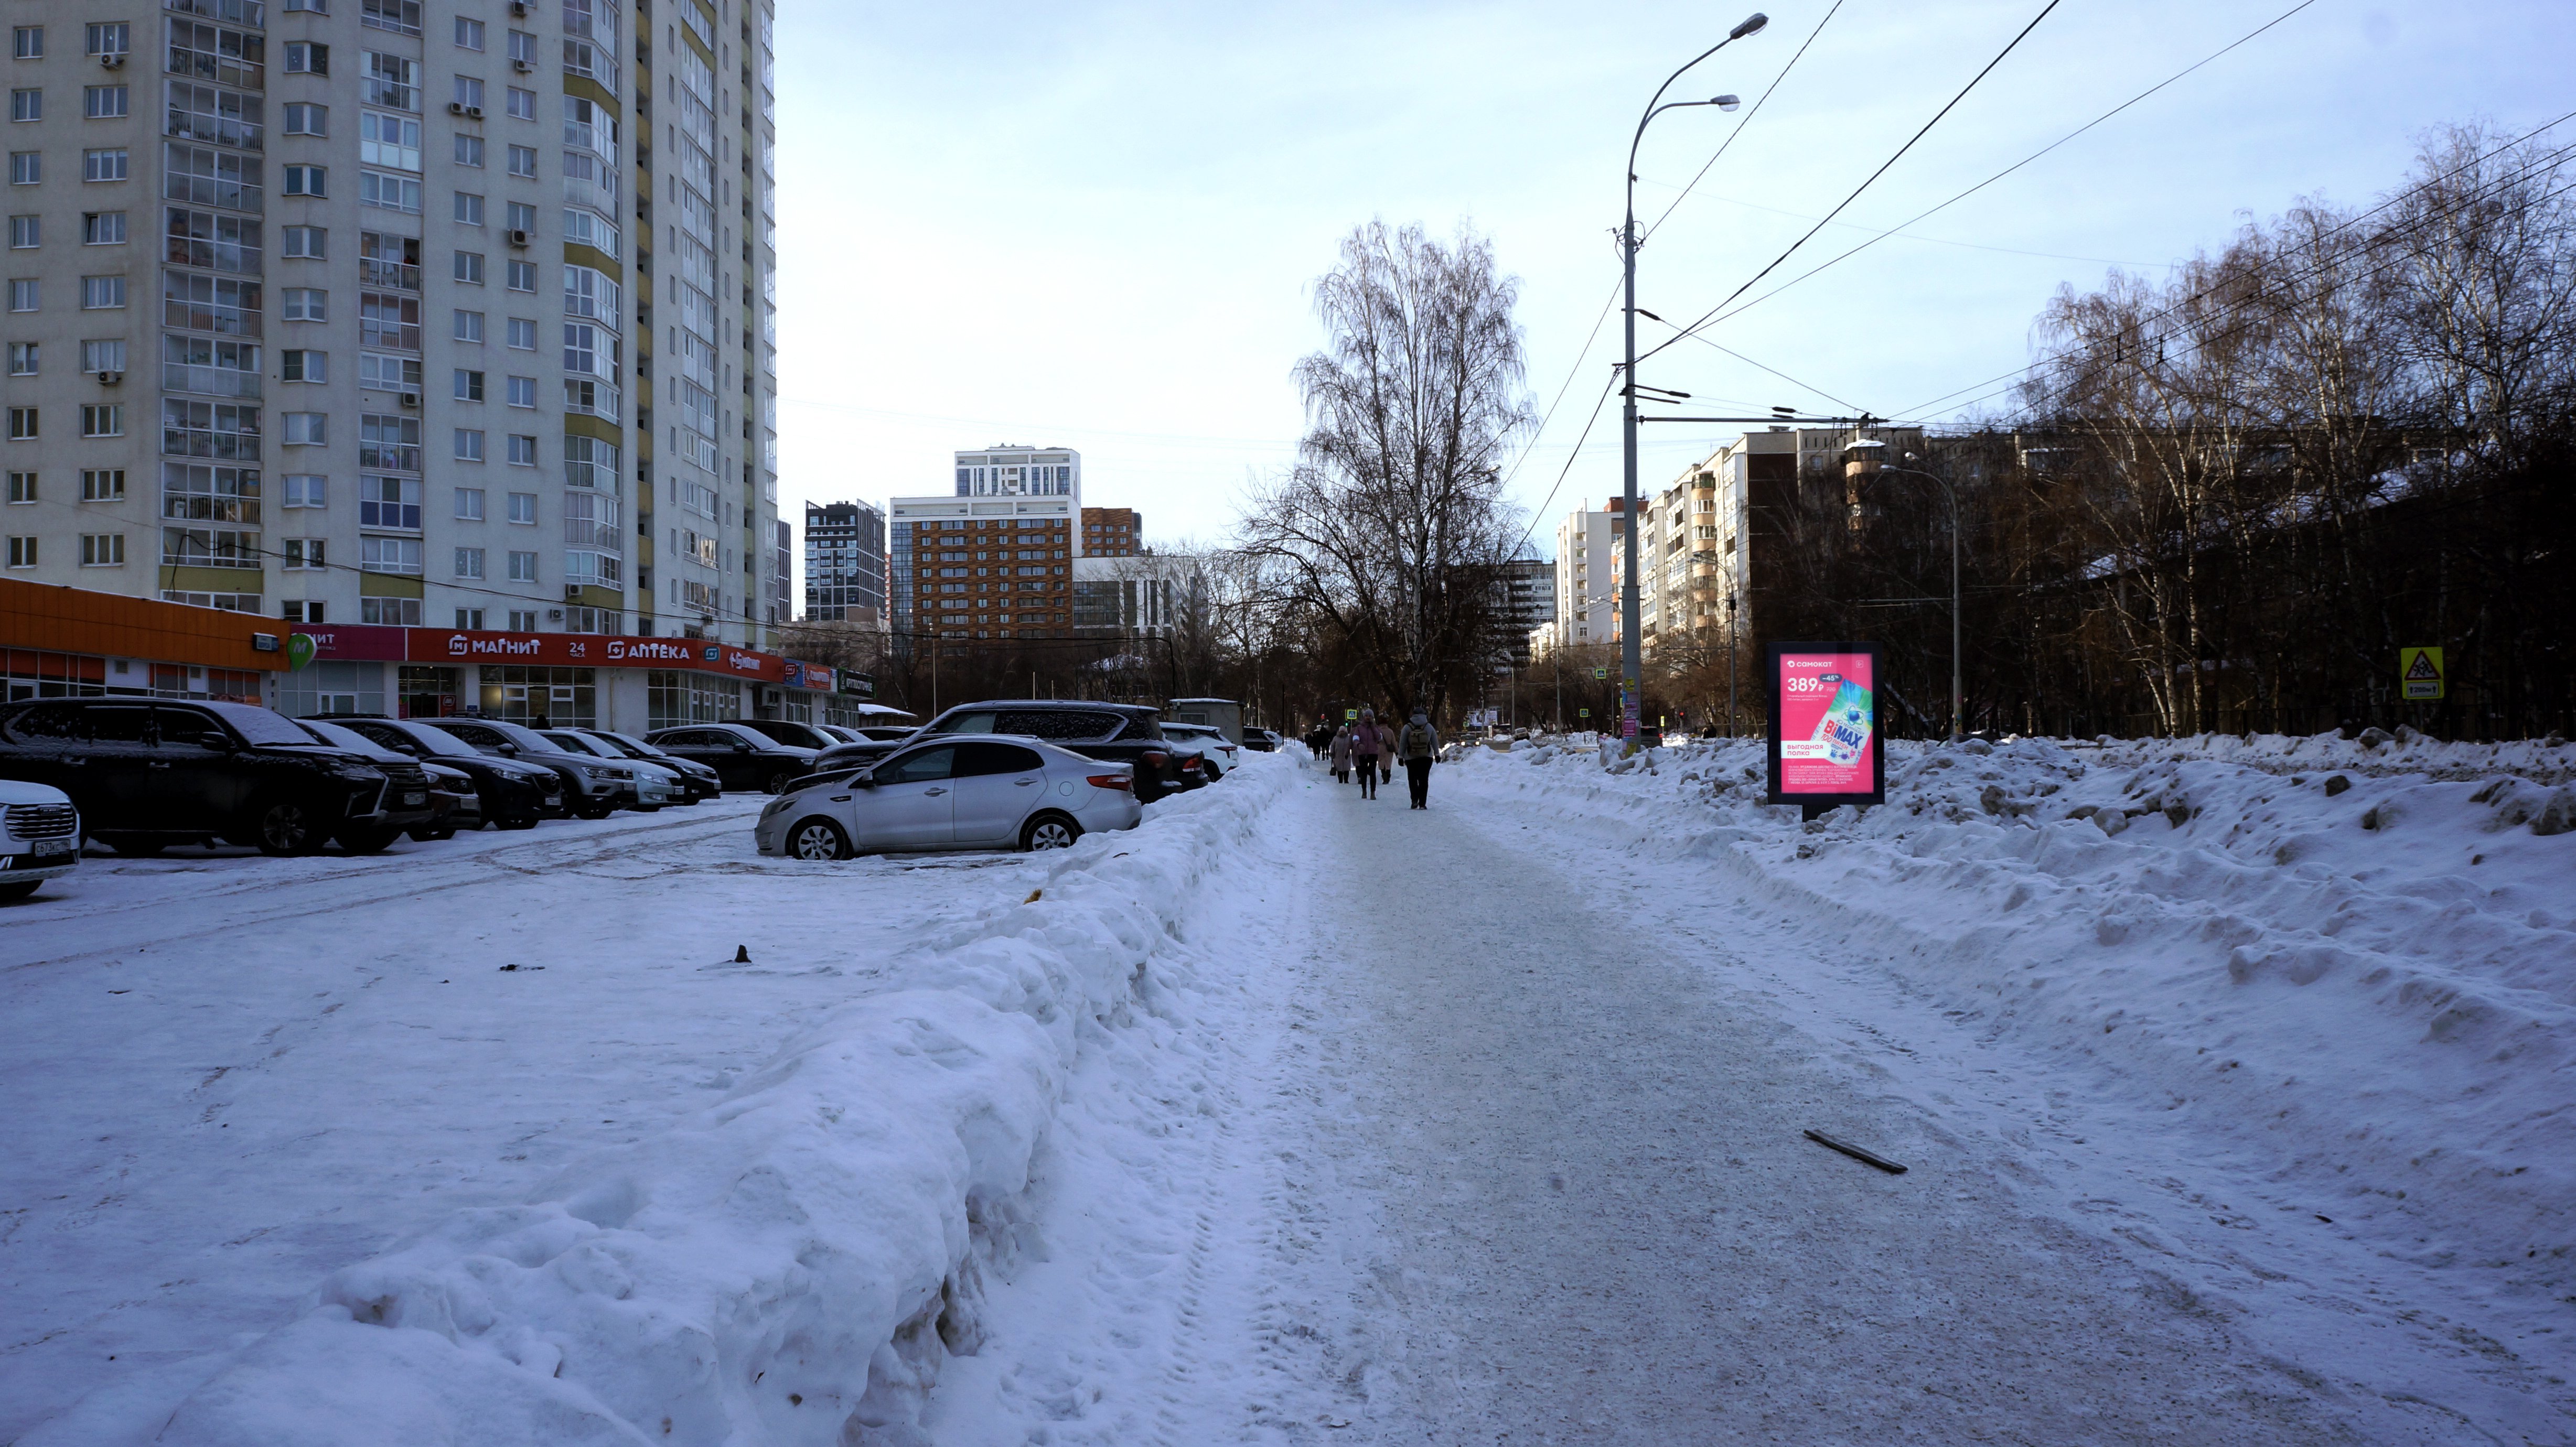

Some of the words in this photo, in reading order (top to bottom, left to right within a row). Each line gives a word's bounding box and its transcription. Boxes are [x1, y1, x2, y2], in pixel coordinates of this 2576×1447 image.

[472, 639, 541, 654] МАГНИТ
[569, 642, 586, 653] 24
[628, 643, 690, 659] АПТЕКА
[1843, 722, 1865, 735] TECHNOLOGY
[1821, 733, 1833, 743] 100
[1832, 739, 1849, 750] ПЯТЕН
